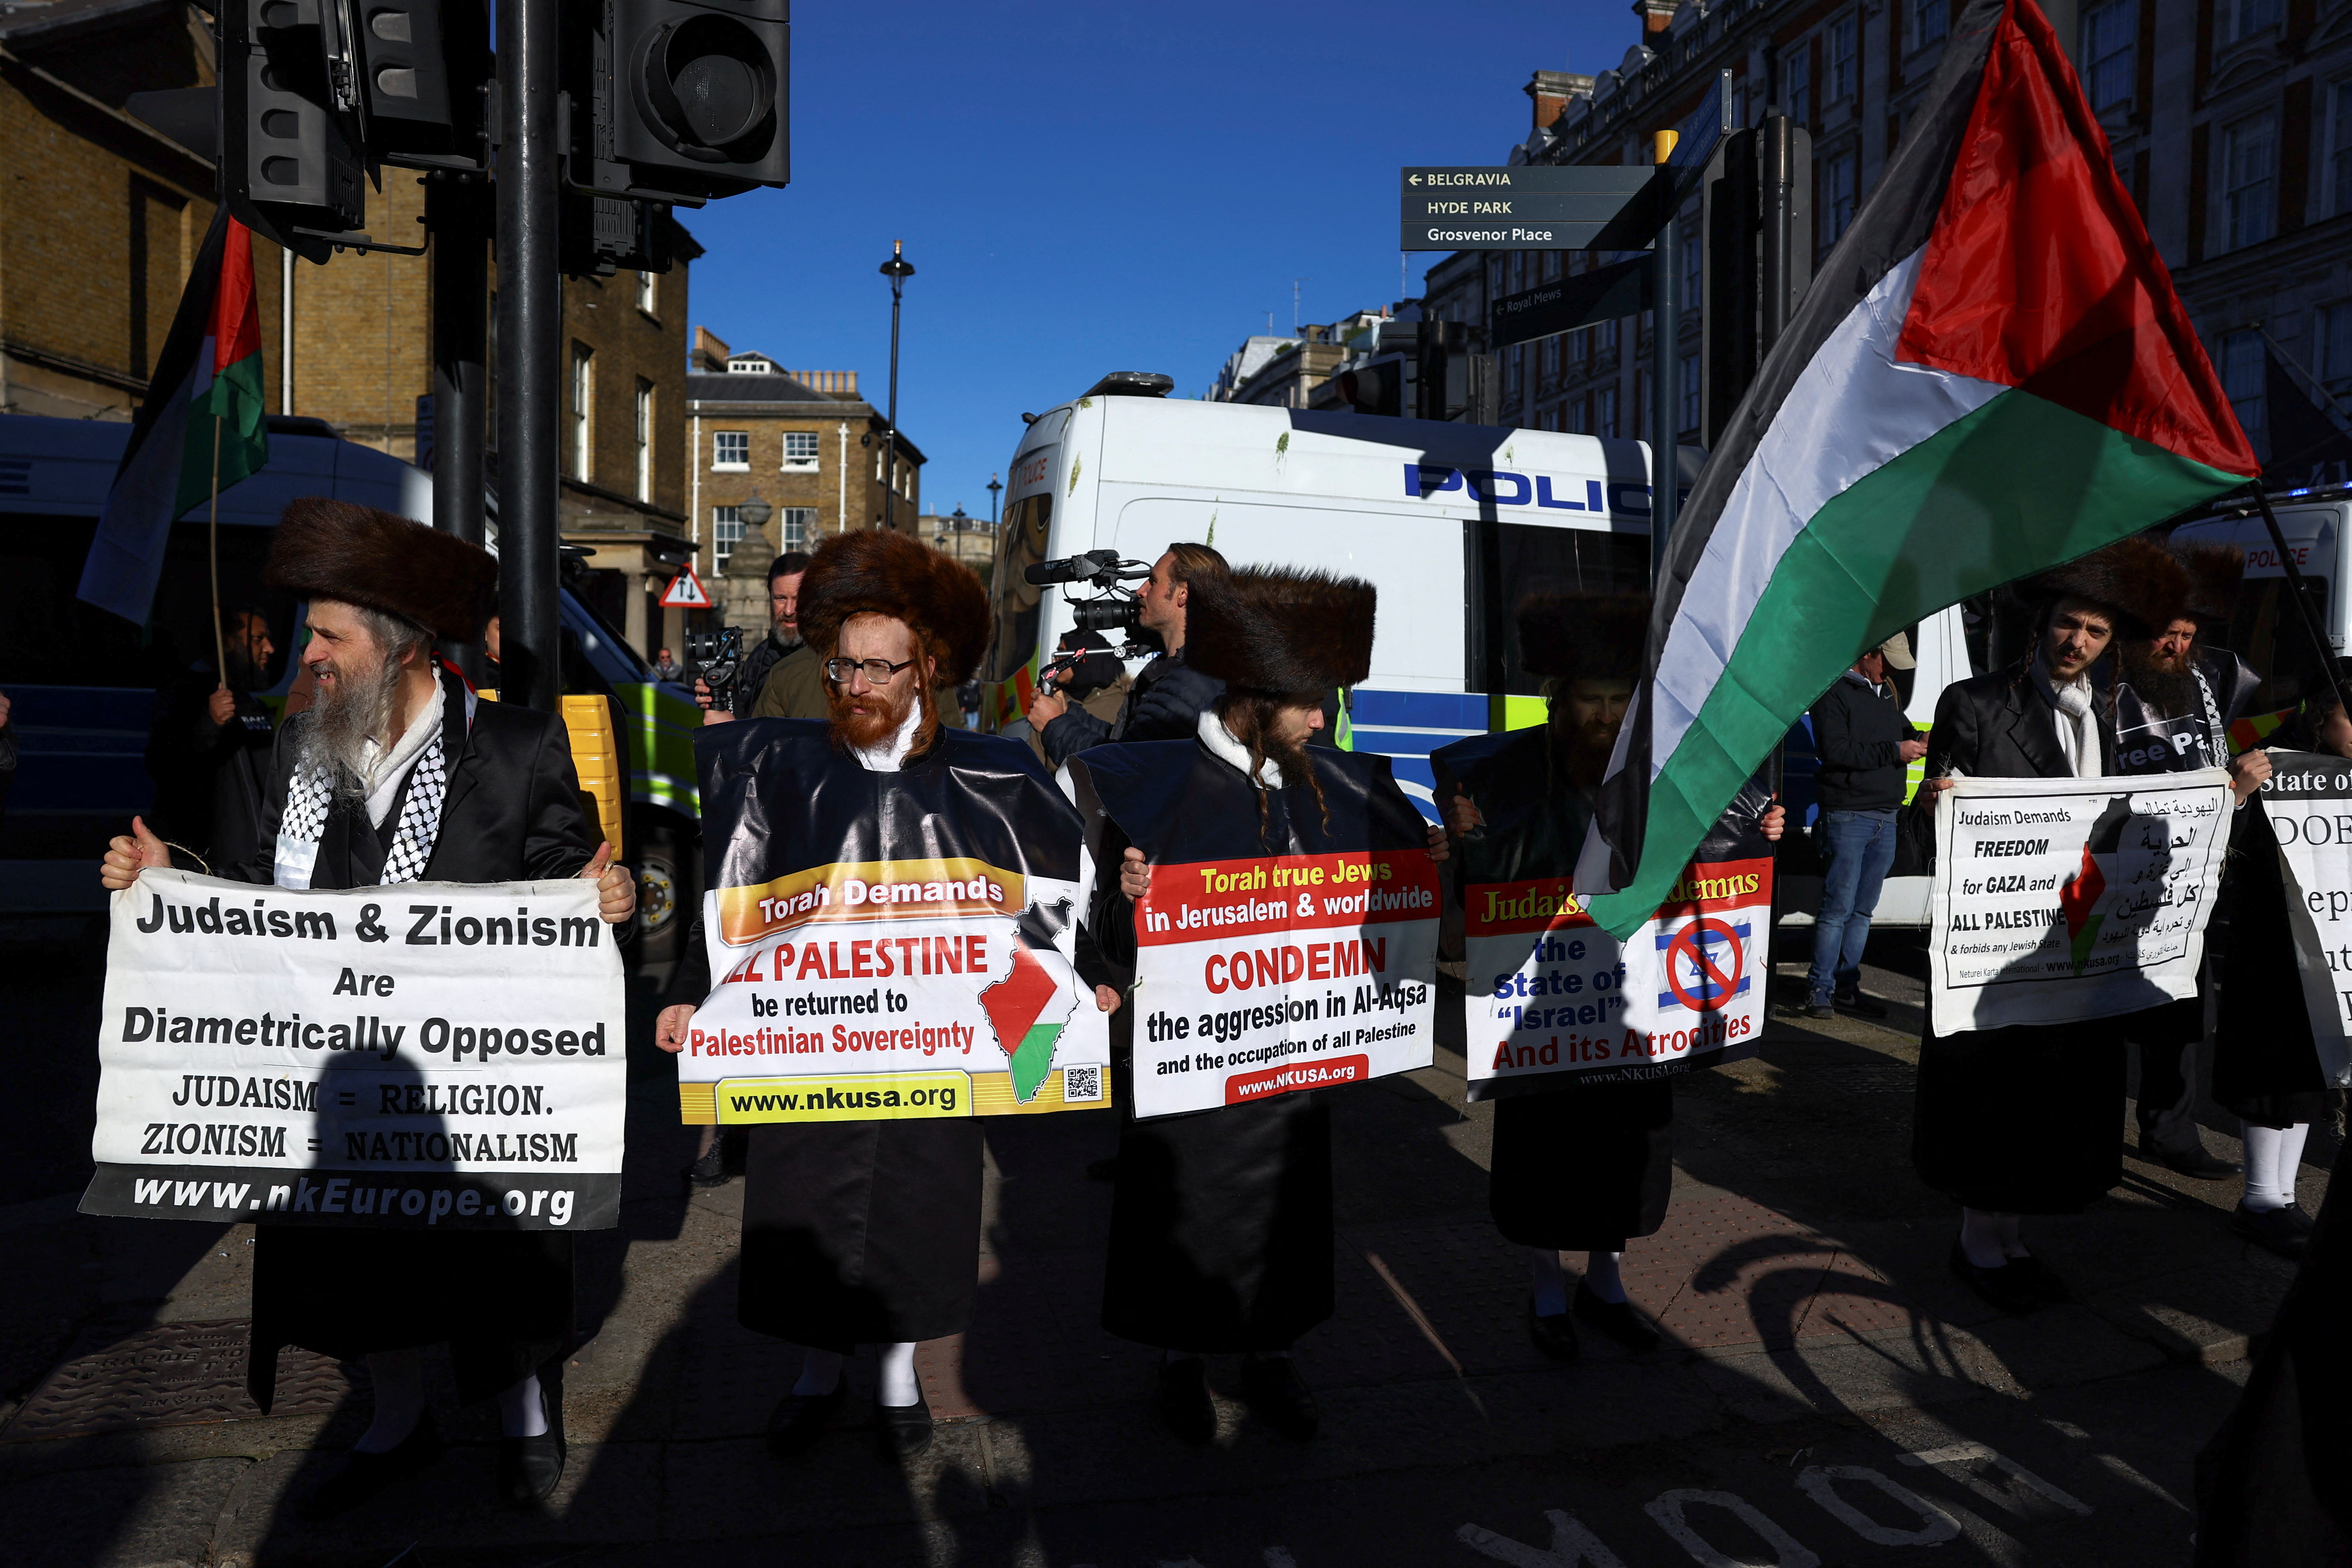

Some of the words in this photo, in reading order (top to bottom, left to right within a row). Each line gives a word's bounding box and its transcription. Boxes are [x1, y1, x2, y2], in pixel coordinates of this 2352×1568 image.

[1427, 173, 1511, 186] BELGRAVIA
[1428, 201, 1468, 214] HYDE
[1474, 201, 1513, 213] PARK
[1427, 228, 1507, 241] Grosvenor
[1513, 227, 1552, 241] Place
[1507, 295, 1533, 313] Royal
[1534, 288, 1561, 305] Mews
[1404, 463, 1652, 517] POLIC
[2115, 744, 2166, 770] ree
[2260, 770, 2327, 791] State
[1959, 811, 2012, 826] Judaism
[2015, 808, 2071, 824] Demands
[2134, 801, 2171, 820] تطالب
[2174, 797, 2217, 818] اليهودية
[1974, 839, 2049, 858] FREEDOM
[2141, 826, 2197, 856] الحرية
[1200, 865, 1267, 894] Torah
[1272, 863, 1324, 888] true
[1331, 859, 1392, 884] Jews
[1962, 879, 1982, 895] for
[1986, 875, 2026, 893] GAZA
[2030, 874, 2056, 891] and
[2146, 860, 2169, 882] غزة
[759, 882, 831, 924] Torah
[843, 874, 1004, 905] Demands
[1145, 907, 1170, 933] in
[1176, 897, 1288, 930] Jerusalem
[1296, 892, 1316, 918] &
[1324, 886, 1433, 916] worldwide
[1481, 885, 1585, 924] Judais
[2116, 883, 2173, 920] فلسطين
[2177, 883, 2199, 908] كل
[136, 893, 337, 940] Judaism
[356, 903, 390, 943] &
[405, 904, 600, 947] Zionism
[1951, 912, 1981, 932] ALL
[1985, 907, 2067, 930] PALESTINE
[774, 935, 988, 981] PALESTINE
[1532, 936, 1586, 963] the
[1950, 946, 1957, 954] &
[1960, 943, 1990, 954] forbids
[1992, 942, 2008, 953] any
[2009, 939, 2036, 951] Jewish
[2038, 939, 2060, 949] State
[1204, 937, 1386, 994] CONDEMN
[1493, 970, 1583, 999] State
[1593, 962, 1626, 990] of
[1959, 969, 1982, 978] Neturei
[1983, 967, 1999, 976] Karta
[2000, 964, 2039, 975] International
[2046, 954, 2120, 972] www.nkusa.org
[333, 967, 395, 997] Are
[752, 993, 778, 1017] be
[785, 988, 878, 1016] returned
[886, 989, 907, 1012] to
[1147, 1010, 1190, 1043] the
[1197, 995, 1318, 1043] aggression
[1326, 990, 1346, 1019] in
[1353, 983, 1427, 1016] Al-Aqsa
[122, 1007, 406, 1061] Diametrically
[420, 1017, 605, 1062] Opposed
[691, 1028, 824, 1057] Palestinian
[831, 1020, 975, 1057] Sovereignty
[1156, 1054, 1190, 1076] and
[1196, 1053, 1224, 1071] the
[1228, 1038, 1307, 1066] occupation
[1312, 1034, 1328, 1051] of
[1332, 1031, 1350, 1050] all
[1355, 1021, 1416, 1045] Palestine
[1492, 1036, 1559, 1071] And
[1569, 1033, 1610, 1063] its
[1620, 1013, 1751, 1058] Atrocities
[1238, 1065, 1356, 1096] www.NKUSA.org
[1579, 1062, 1691, 1085] www.NKUSA.org
[172, 1074, 318, 1112] JUDAISM
[380, 1084, 553, 1116] RELIGION.
[730, 1087, 956, 1112] www.nkusa.org
[140, 1122, 287, 1157] ZIONISM
[346, 1131, 578, 1161] NATIONALISM
[133, 1178, 575, 1225] www.nkEurope.org
